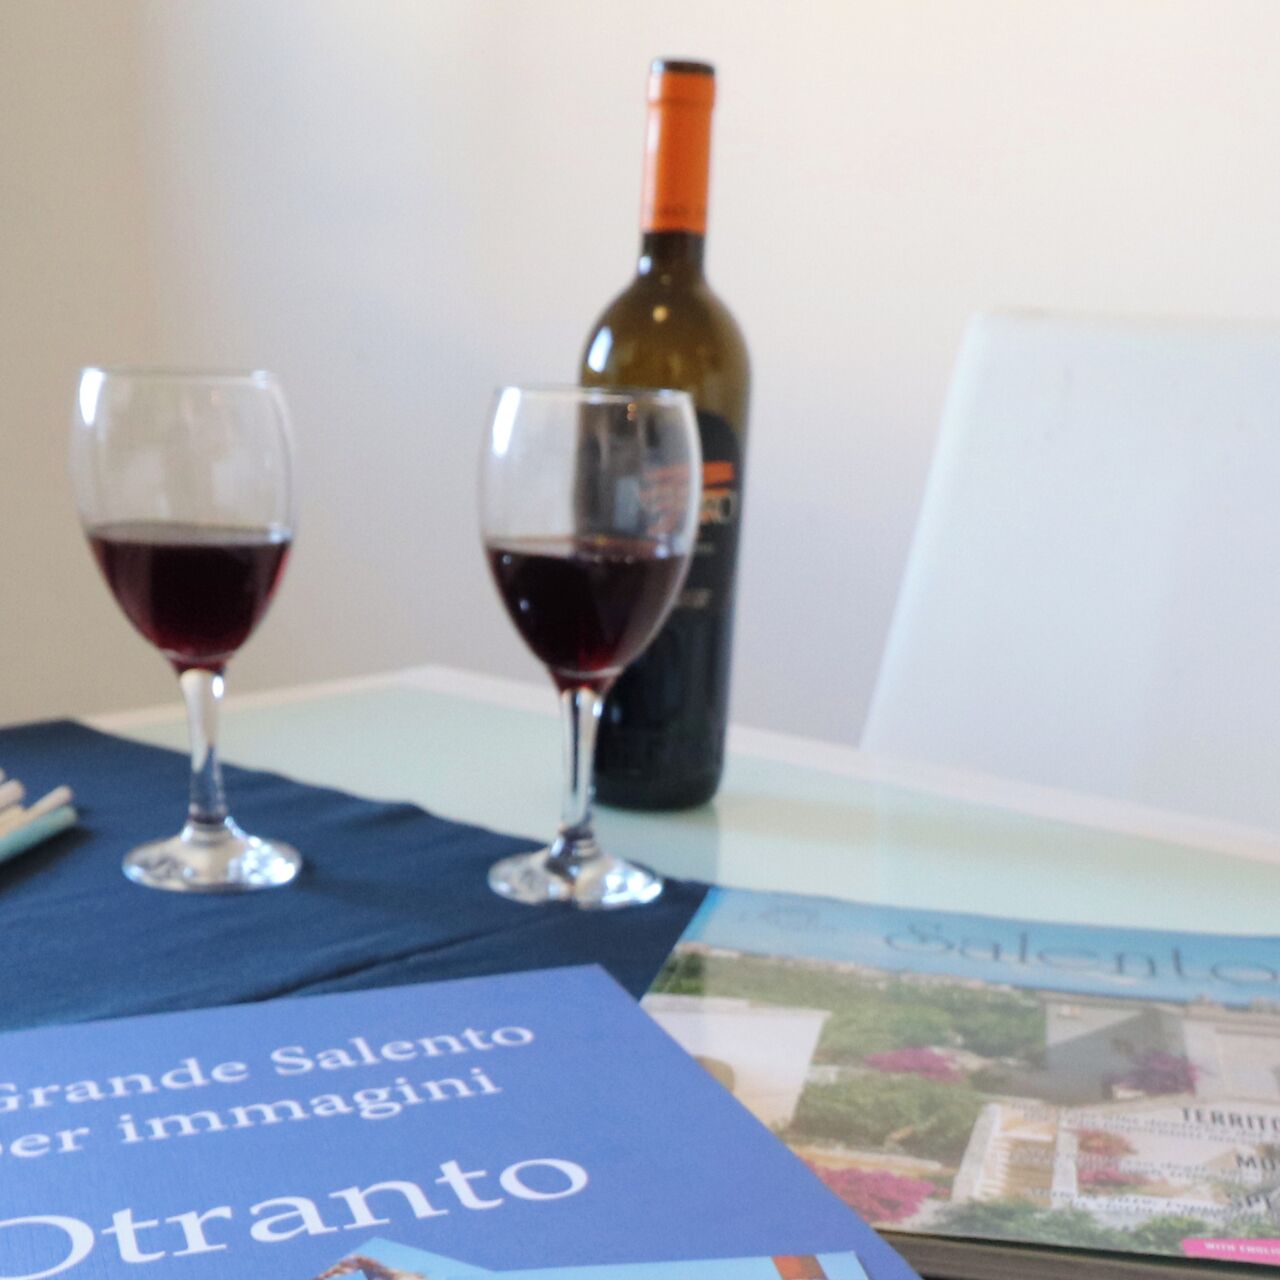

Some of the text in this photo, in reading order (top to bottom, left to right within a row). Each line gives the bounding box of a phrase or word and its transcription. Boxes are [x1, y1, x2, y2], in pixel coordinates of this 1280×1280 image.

[884, 922, 1278, 984] Salento
[270, 1026, 535, 1076] Salento
[117, 1066, 503, 1144] immagini
[1203, 1240, 1237, 1254] WITH
